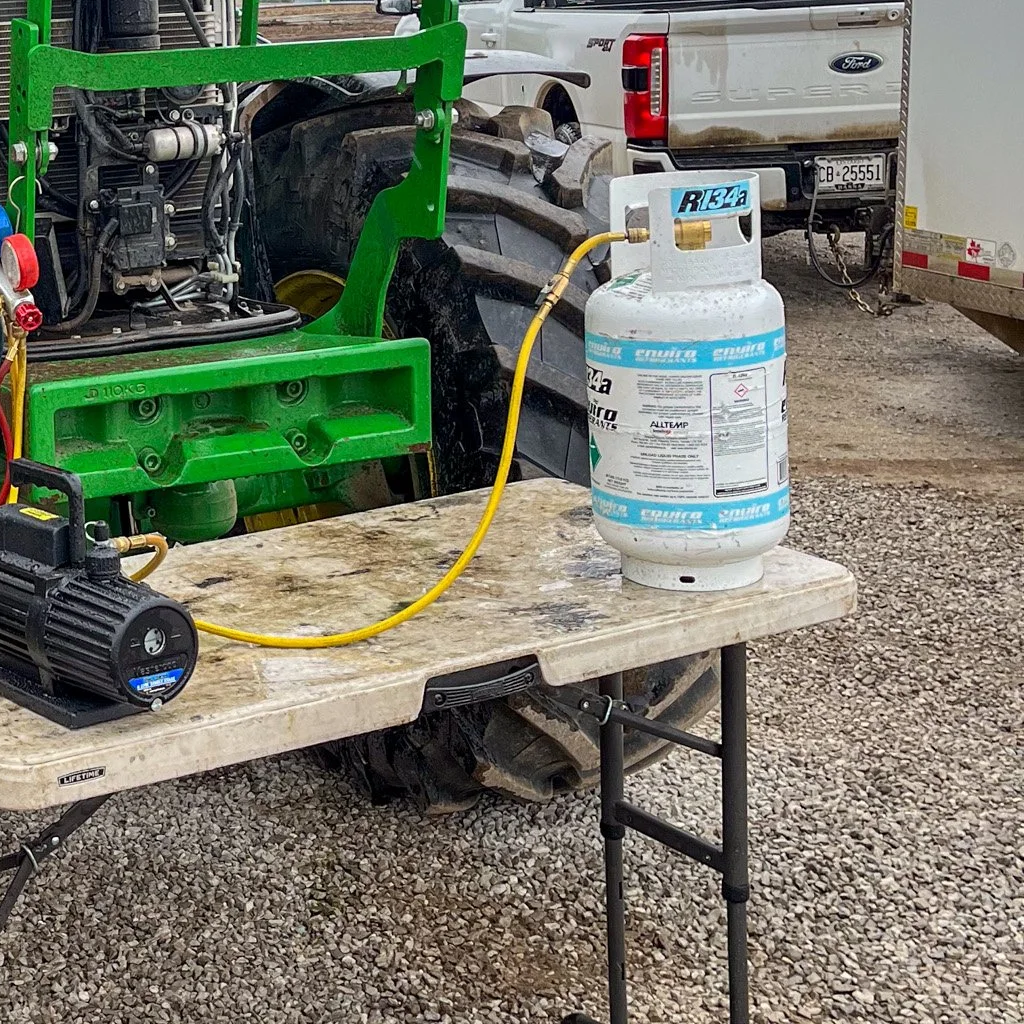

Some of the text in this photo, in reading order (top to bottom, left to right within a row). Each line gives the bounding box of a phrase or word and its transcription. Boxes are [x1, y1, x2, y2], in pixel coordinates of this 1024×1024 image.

[841, 56, 872, 69] Ford
[691, 83, 869, 104] SUPER
[818, 164, 881, 183] CB 25551
[677, 185, 748, 213] R134a
[650, 421, 689, 429] ALLTEMP
[63, 769, 100, 783] LIFETIME
